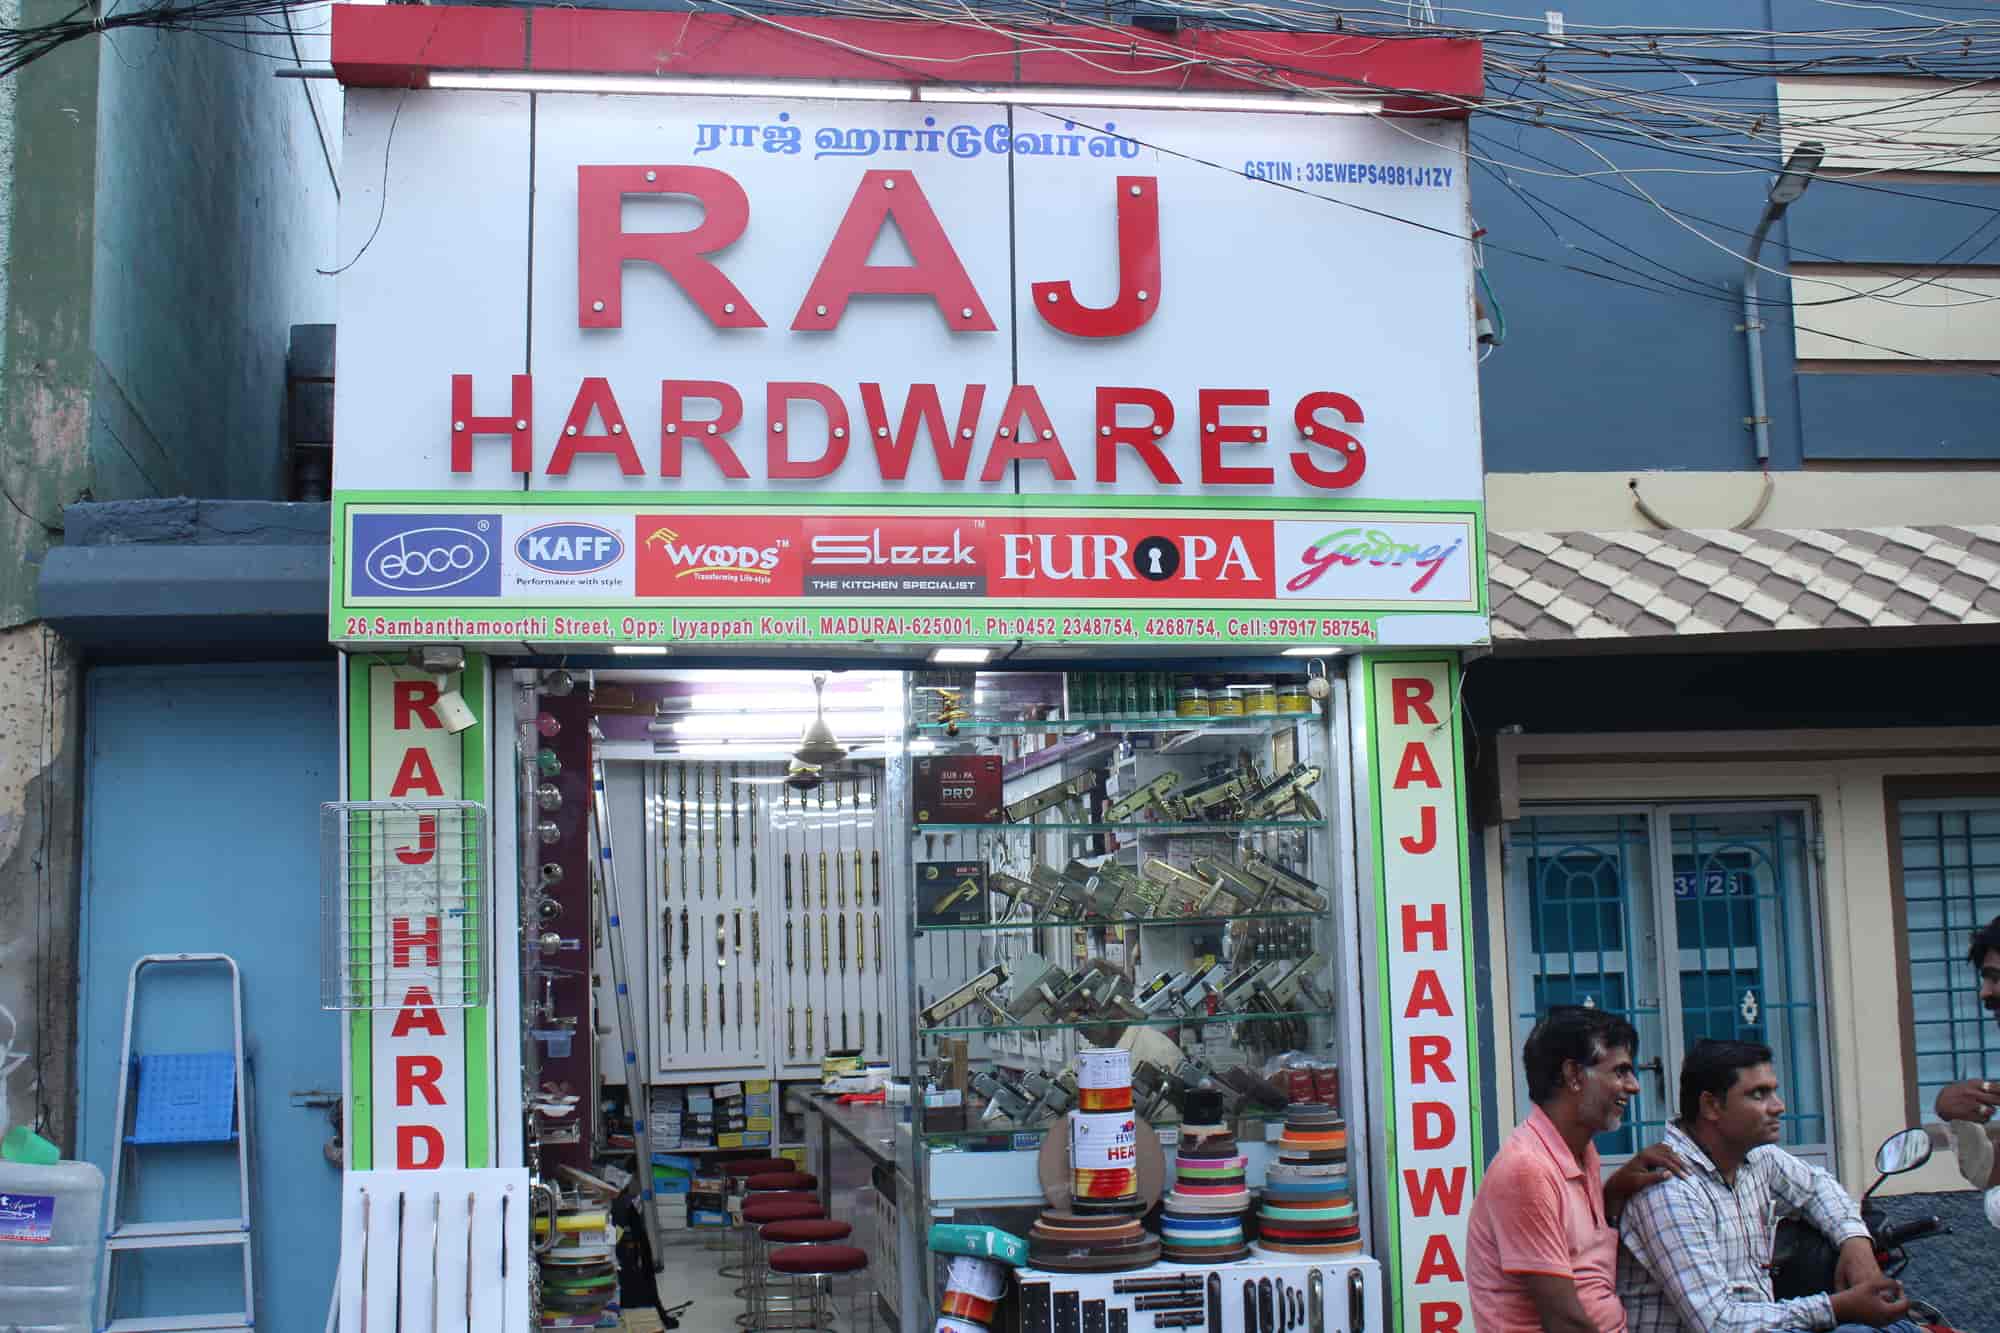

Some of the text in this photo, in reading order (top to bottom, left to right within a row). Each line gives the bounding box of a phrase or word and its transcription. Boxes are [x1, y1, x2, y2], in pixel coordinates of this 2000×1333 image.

[693, 112, 801, 155] ராஜ்
[1245, 160, 1292, 181] GSTIN
[1305, 163, 1453, 188] 33EWEPS4981J1ZY
[578, 165, 1162, 338] RAJ
[451, 374, 1367, 489] HARDWARES
[380, 535, 474, 579] ebco
[528, 536, 612, 561] KAFF
[811, 527, 976, 564] Sleek
[1286, 528, 1462, 593] Godrej
[516, 577, 623, 587] Performance with style
[812, 580, 976, 590] THE KITCHEN SPECIALIST
[622, 617, 664, 637] Opp:
[672, 617, 753, 637] Iyyappan
[1391, 678, 1443, 856] RAJ
